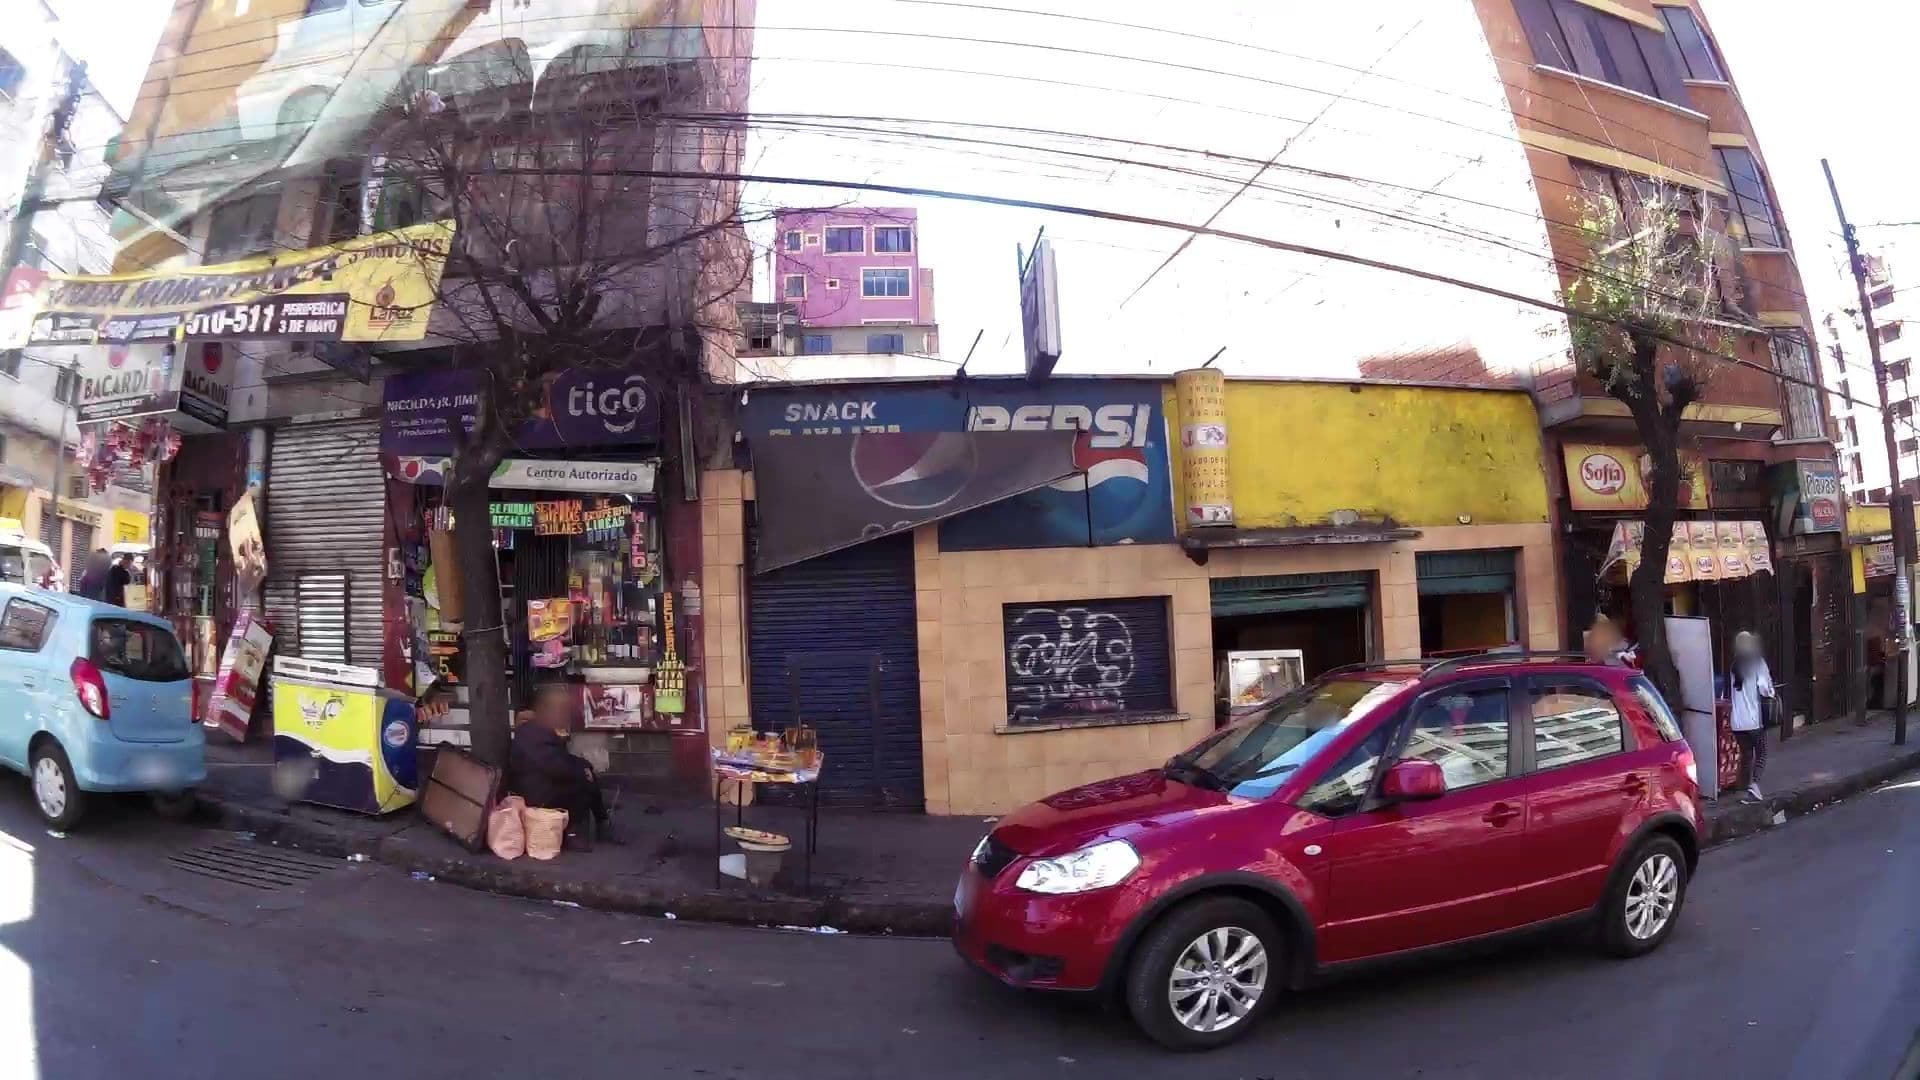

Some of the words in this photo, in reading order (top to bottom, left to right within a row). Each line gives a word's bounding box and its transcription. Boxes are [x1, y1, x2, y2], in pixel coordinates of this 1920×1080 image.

[305, 318, 337, 333] MAYO
[784, 401, 877, 422] SNACK
[967, 403, 1152, 448] PEPSI
[526, 466, 565, 479] Centro
[569, 467, 638, 482] Autorizado
